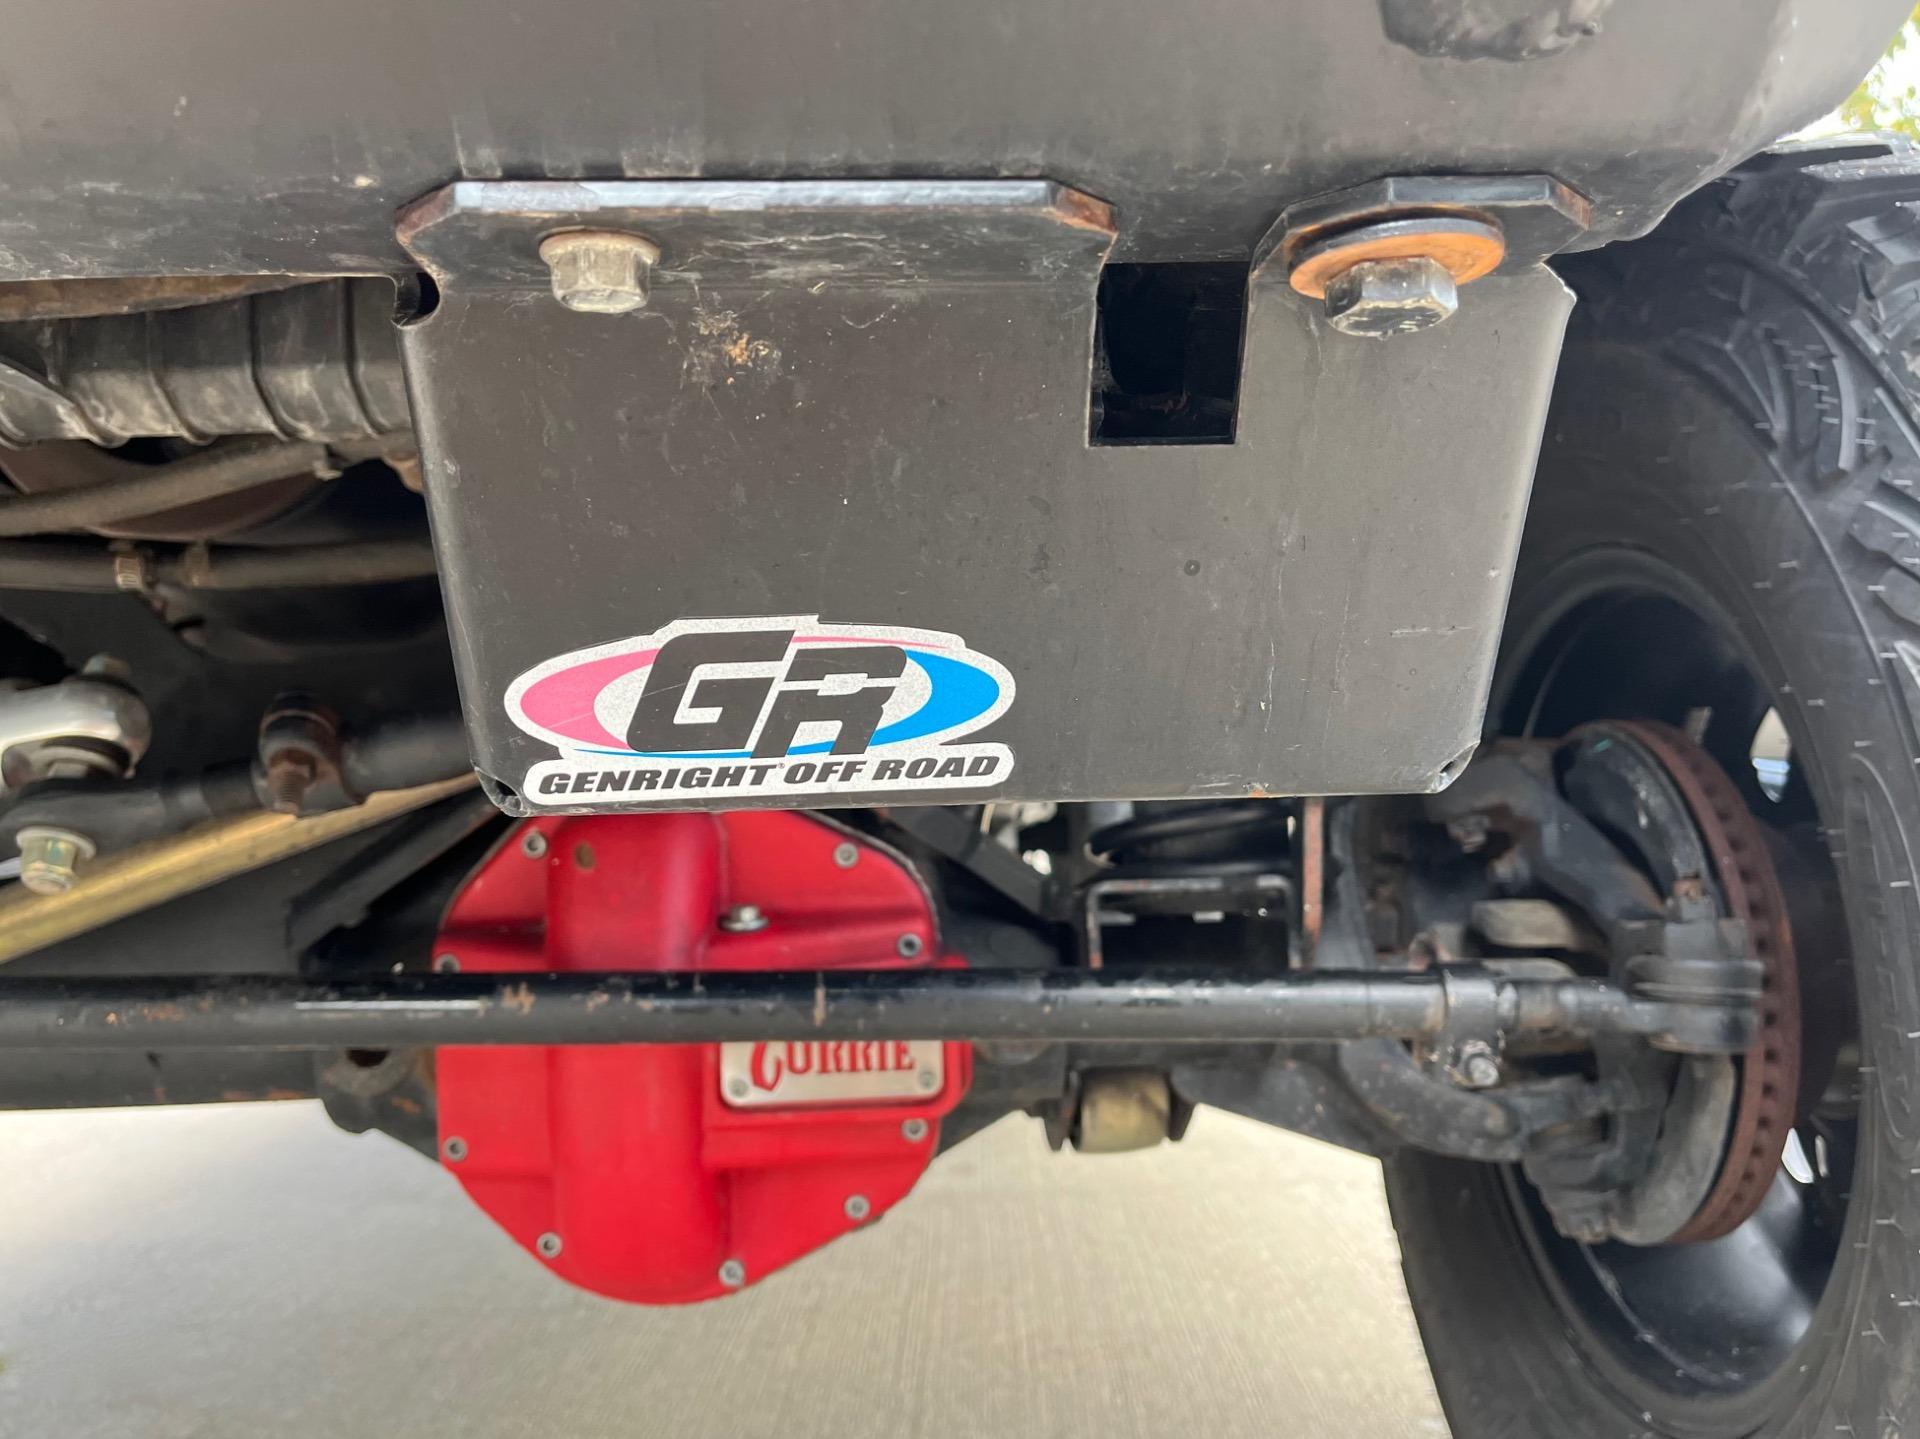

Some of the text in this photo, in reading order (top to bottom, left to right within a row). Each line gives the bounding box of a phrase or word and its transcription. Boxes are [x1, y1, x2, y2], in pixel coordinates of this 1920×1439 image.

[626, 629, 907, 759] GR
[538, 755, 1000, 795] GENRIGHT OFF ROAD
